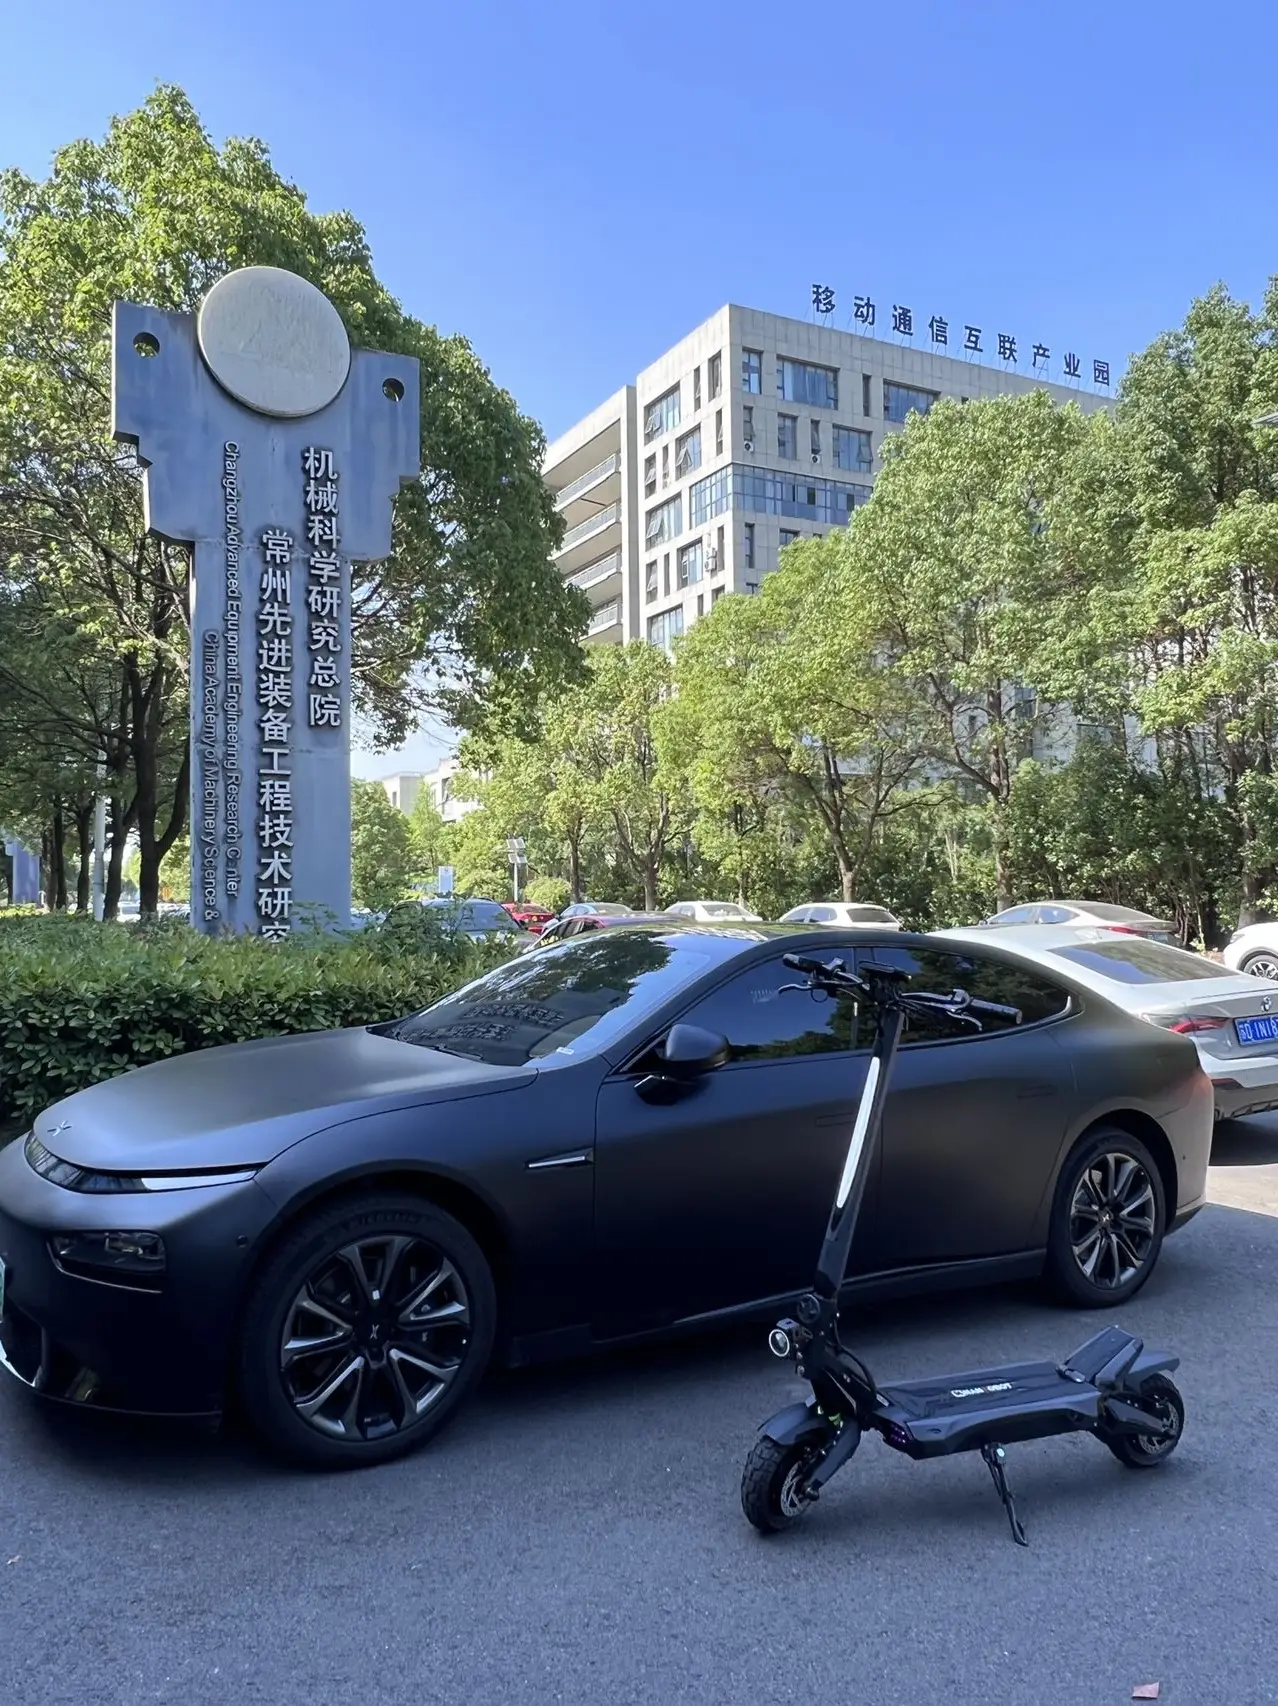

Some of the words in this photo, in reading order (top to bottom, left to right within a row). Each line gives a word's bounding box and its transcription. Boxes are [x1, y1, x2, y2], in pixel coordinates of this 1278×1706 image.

[812, 284, 1110, 386] 移动通信互联产业园
[223, 441, 239, 523] Changzhou
[226, 524, 241, 597] Advanced
[304, 447, 341, 727] 机械科学研究总院
[204, 631, 219, 674] China
[223, 601, 241, 680] Equipment
[201, 675, 219, 749] Academy
[223, 682, 241, 772] Engineering
[204, 750, 219, 767] of
[201, 768, 219, 845] Machinery
[226, 773, 241, 843] Research
[204, 847, 219, 906] Science
[226, 849, 241, 897] Cnter
[204, 909, 219, 921] &
